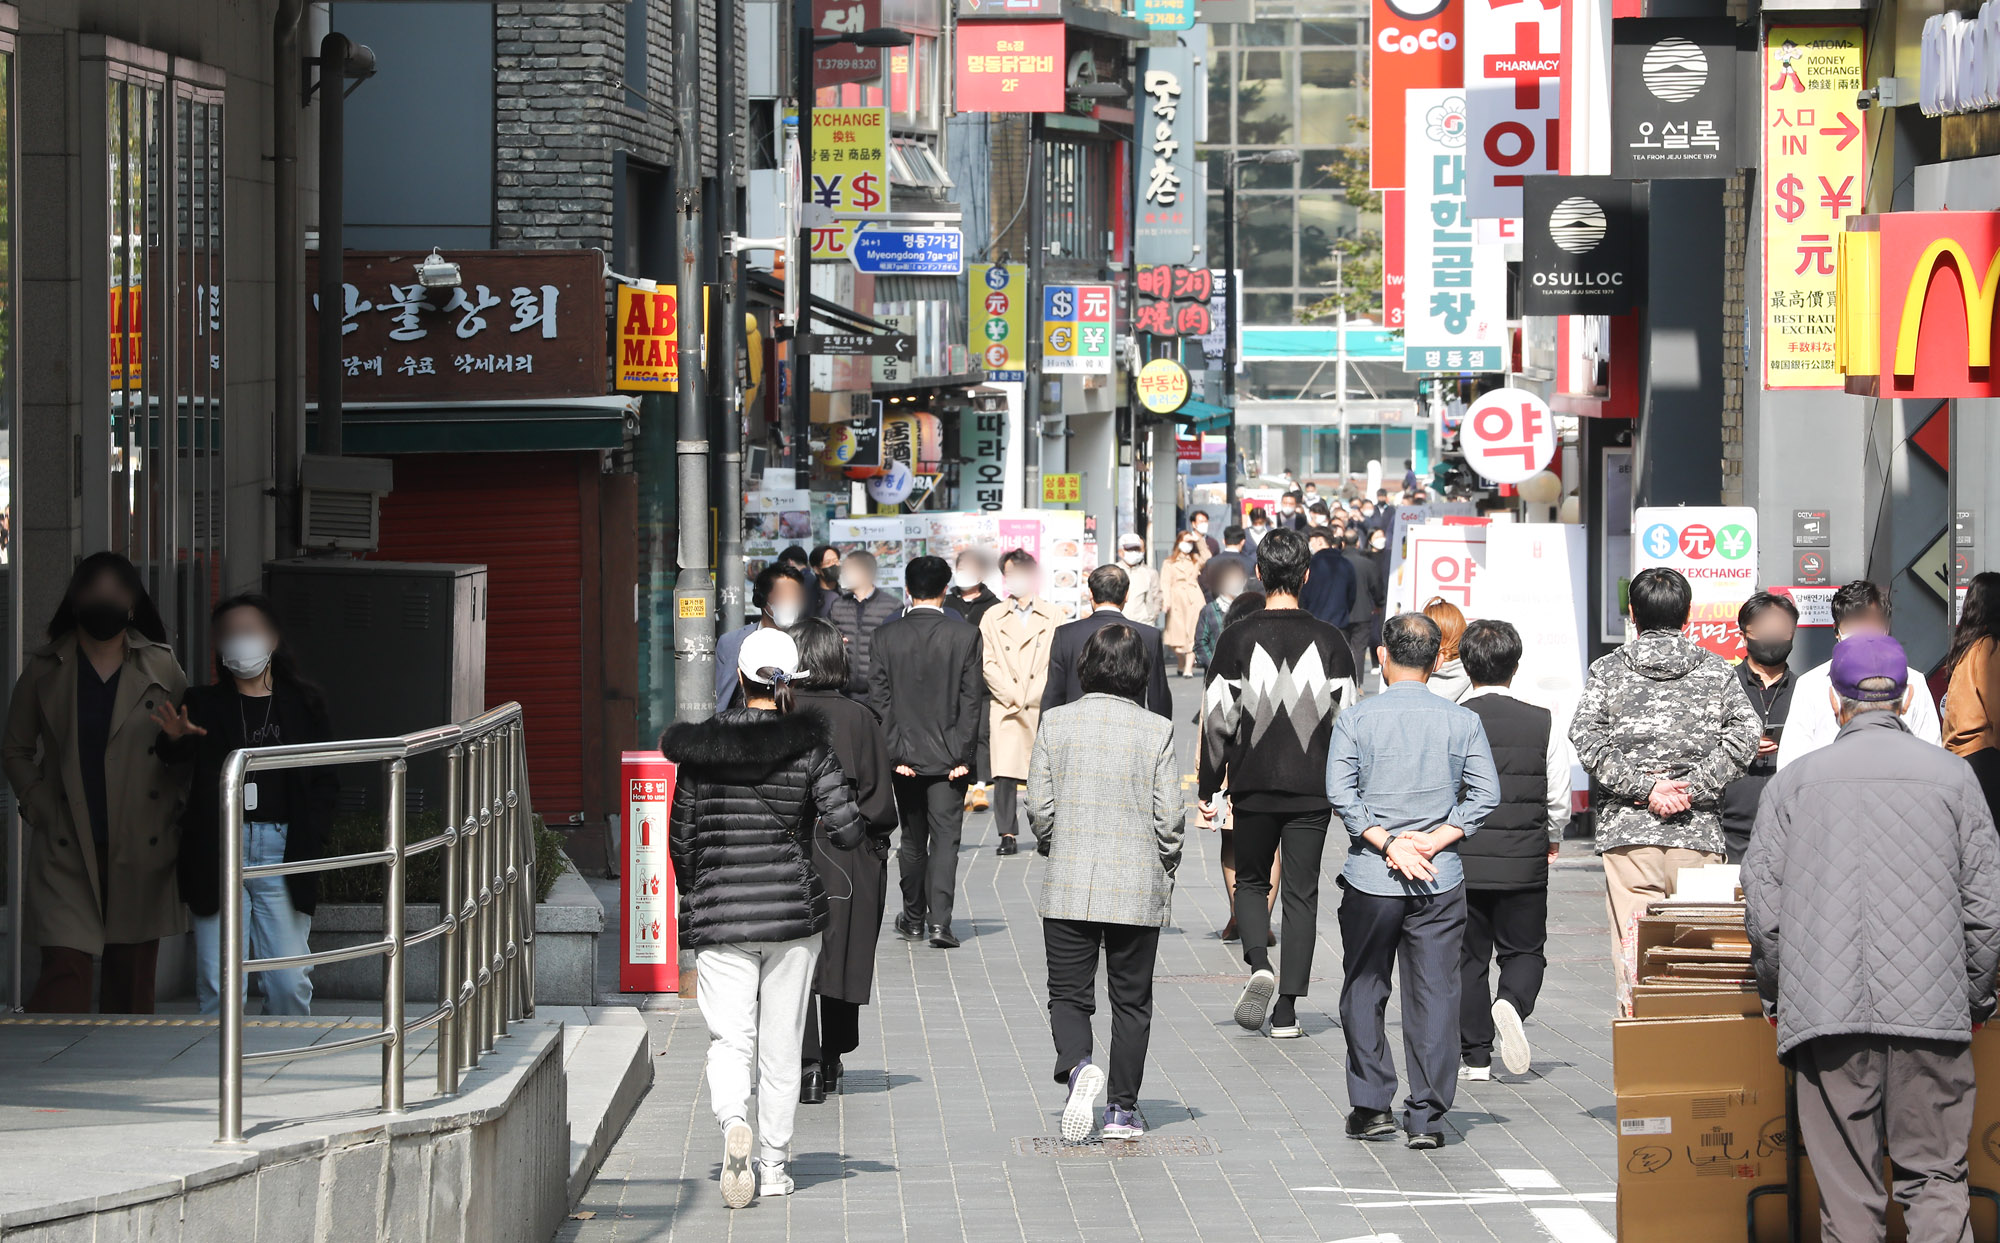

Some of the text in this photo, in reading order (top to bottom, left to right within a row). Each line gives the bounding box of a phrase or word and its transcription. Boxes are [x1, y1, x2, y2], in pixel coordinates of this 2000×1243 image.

[1378, 27, 1456, 54] CoCo
[1804, 40, 1854, 50] <ATOM>
[967, 56, 1053, 73] 명동닭갈비
[1495, 60, 1560, 71] PHARMACY
[1807, 56, 1845, 65] MONEY
[1807, 67, 1860, 75] EXCHANGE
[1002, 79, 1019, 92] 2F
[813, 113, 881, 126] XCHANGE
[1772, 108, 1815, 127] 入口
[1144, 70, 1182, 204] 목우촌
[1629, 120, 1720, 151] 오설록
[1782, 135, 1807, 155] IN
[852, 171, 880, 211] $
[1775, 173, 1854, 223] $ ¥
[902, 234, 958, 249] 명동7가길
[866, 250, 958, 262] Myeongdong 7ga-gil
[1795, 234, 1835, 276] 元
[1137, 264, 1211, 300] 明洞
[1533, 272, 1623, 286] OSULLOC
[1052, 290, 1073, 317] $
[1083, 293, 1107, 317] 元
[623, 294, 677, 336] AB
[1774, 315, 1804, 323] BEST
[1049, 327, 1105, 352] € ¥
[623, 339, 678, 367] MAR
[883, 319, 899, 380] 따오뎅
[1425, 350, 1484, 367] 명동점
[342, 354, 533, 377] 담배 우표 악세서리
[623, 371, 660, 381] MEGA
[1140, 374, 1184, 392] 부동산
[1473, 403, 1542, 470] 약
[976, 414, 1005, 511] 따라오뎅
[1046, 476, 1078, 488] 상품권
[1650, 525, 1746, 557] $ 元 ¥
[1432, 556, 1476, 607] 약
[1688, 568, 1752, 578] EXCHANGE
[632, 783, 665, 793] 사용법
